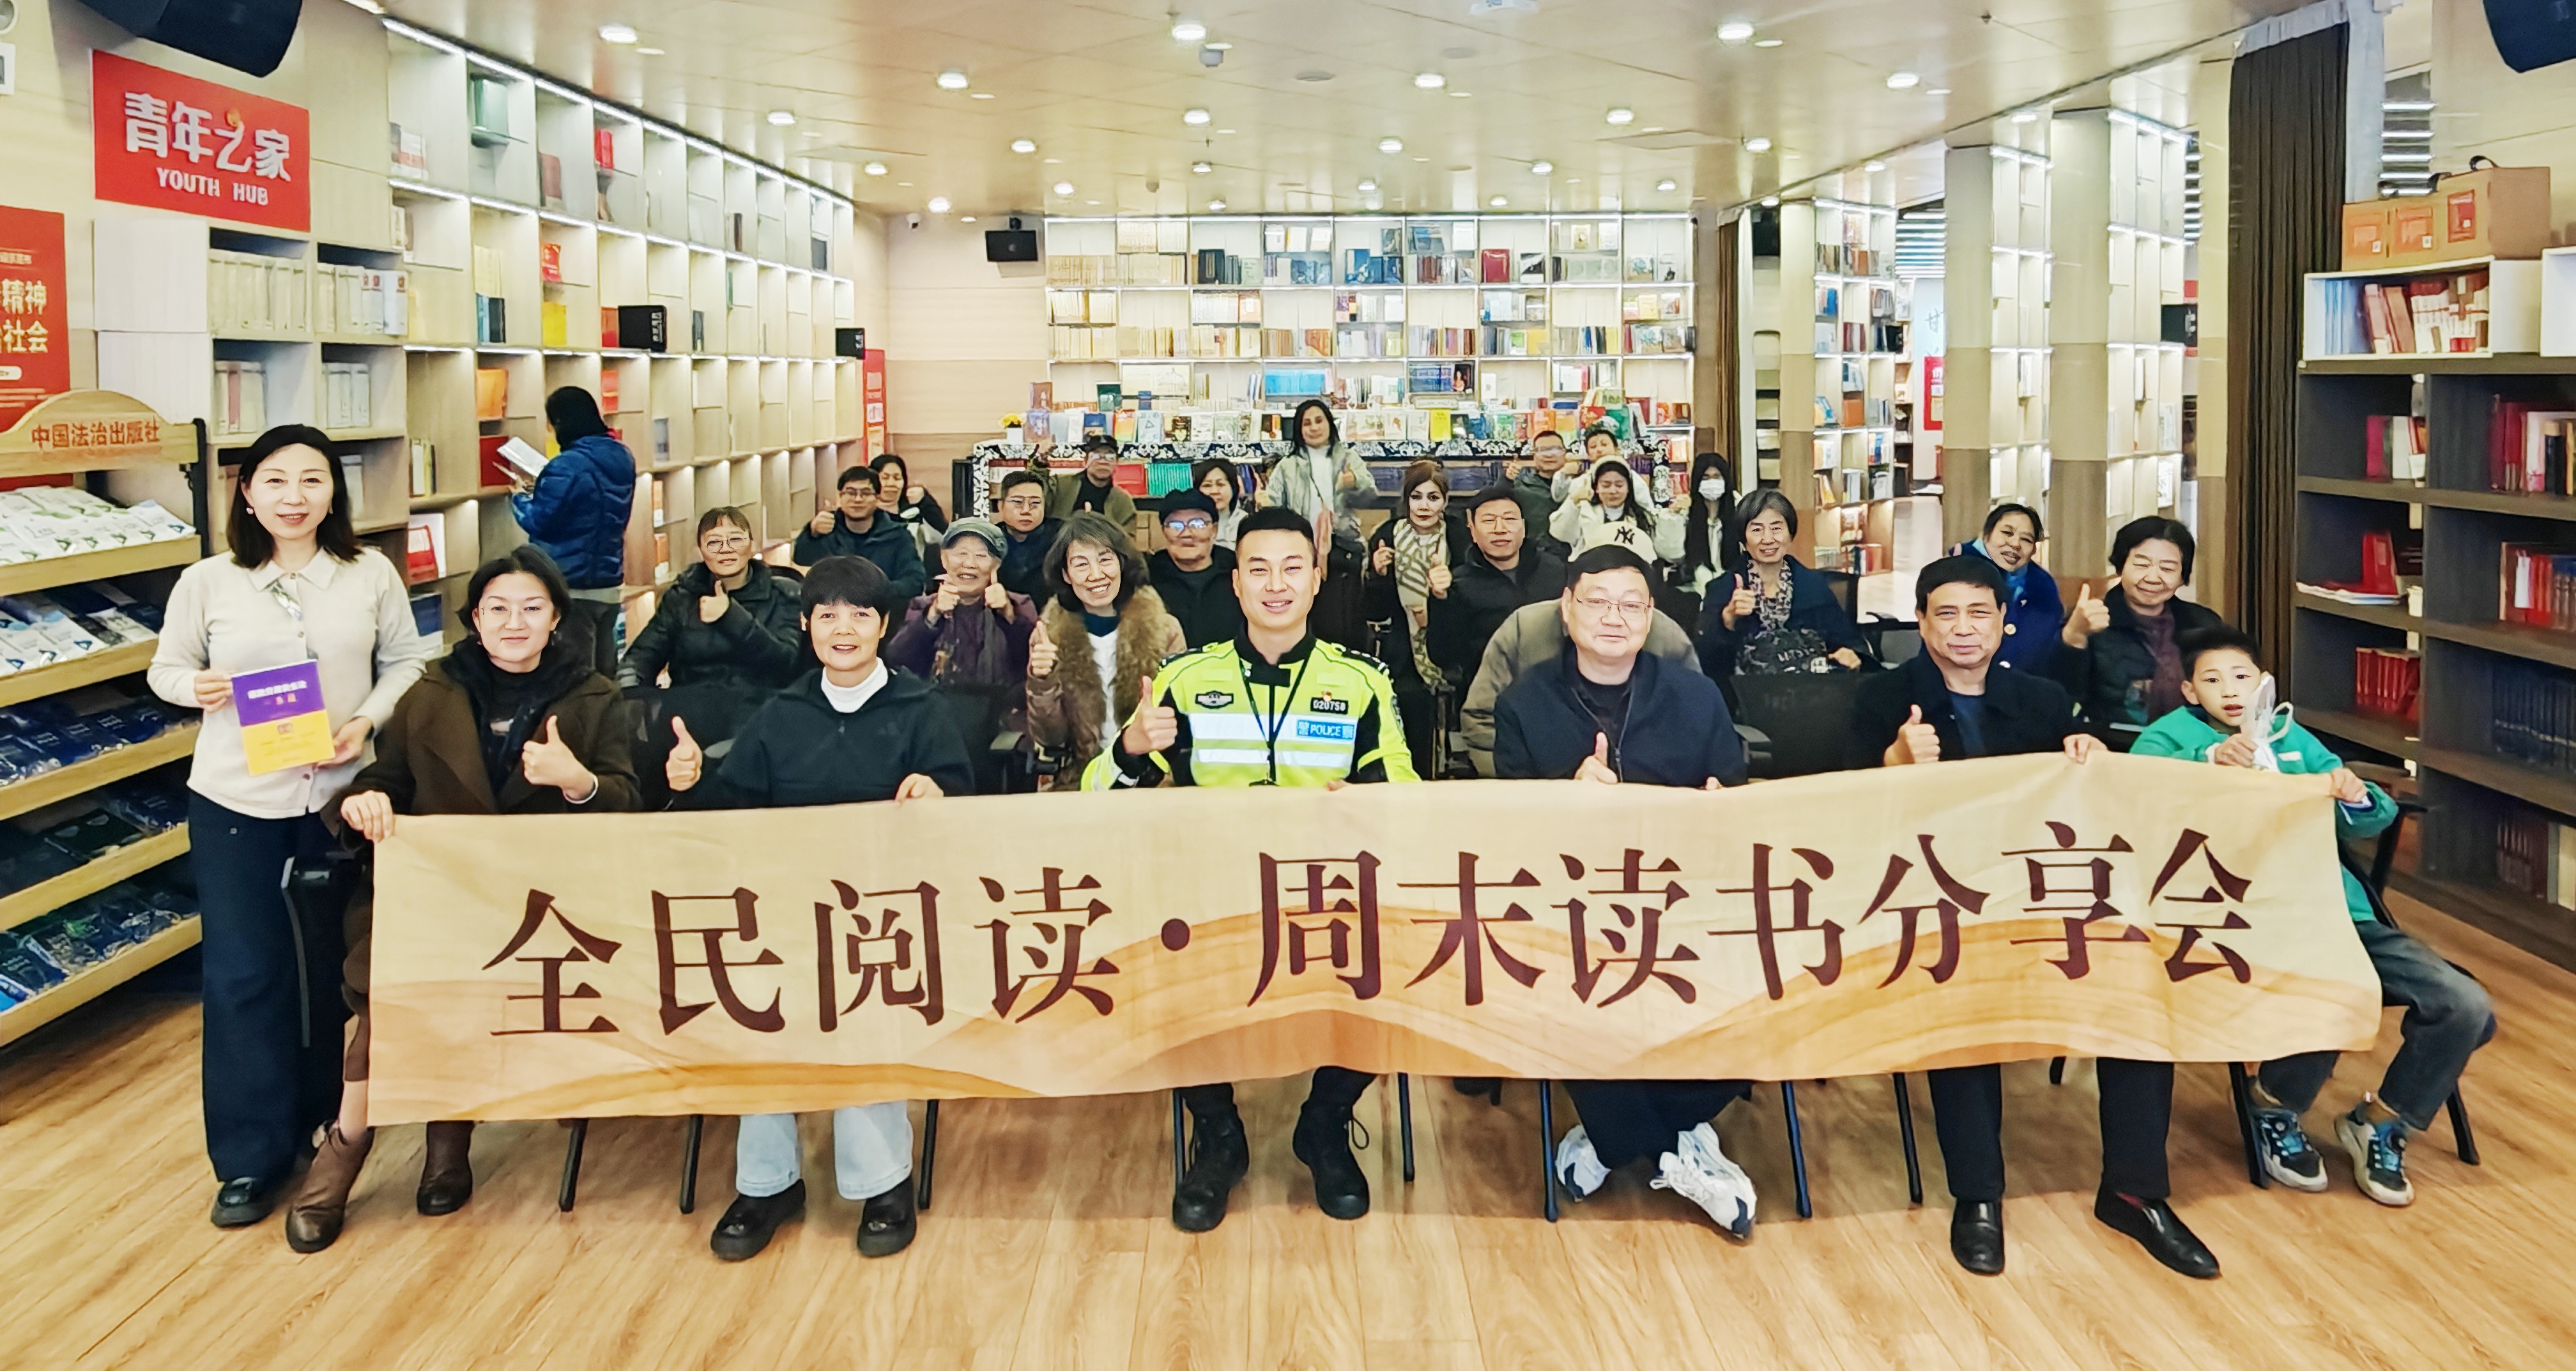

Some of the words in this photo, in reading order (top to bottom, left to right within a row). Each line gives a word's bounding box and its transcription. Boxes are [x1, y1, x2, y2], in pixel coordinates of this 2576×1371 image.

[125, 92, 291, 181] 青年之家
[157, 167, 220, 197] YOUTH
[233, 182, 268, 206] HUB
[32, 415, 160, 449] 中国法治出版社
[1310, 724, 1342, 736] POLICE
[482, 821, 2252, 1036] 全民阅读·周末读书分享会
